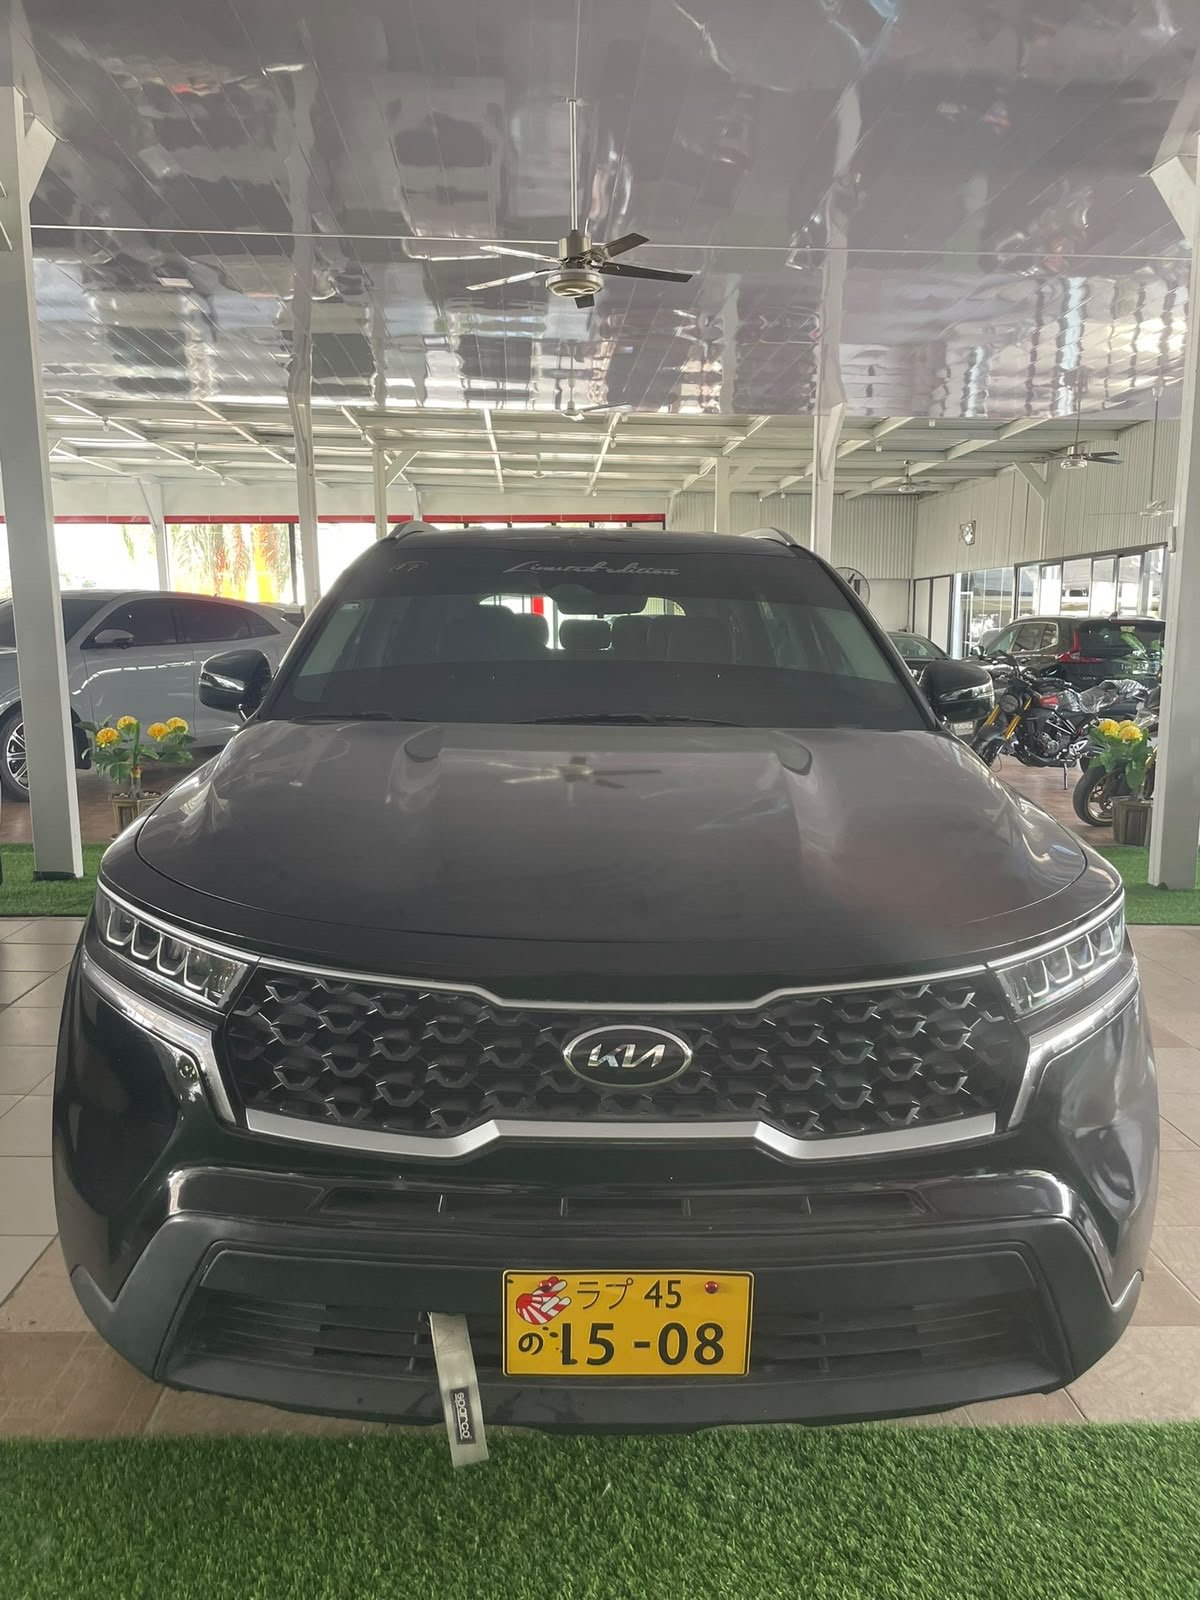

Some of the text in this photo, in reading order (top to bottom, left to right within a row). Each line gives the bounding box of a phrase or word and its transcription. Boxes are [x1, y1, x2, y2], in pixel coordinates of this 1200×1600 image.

[588, 1043, 666, 1068] KIA
[577, 1277, 682, 1310] ラプ 45
[518, 1332, 544, 1355] の
[454, 1391, 471, 1440] sparco
